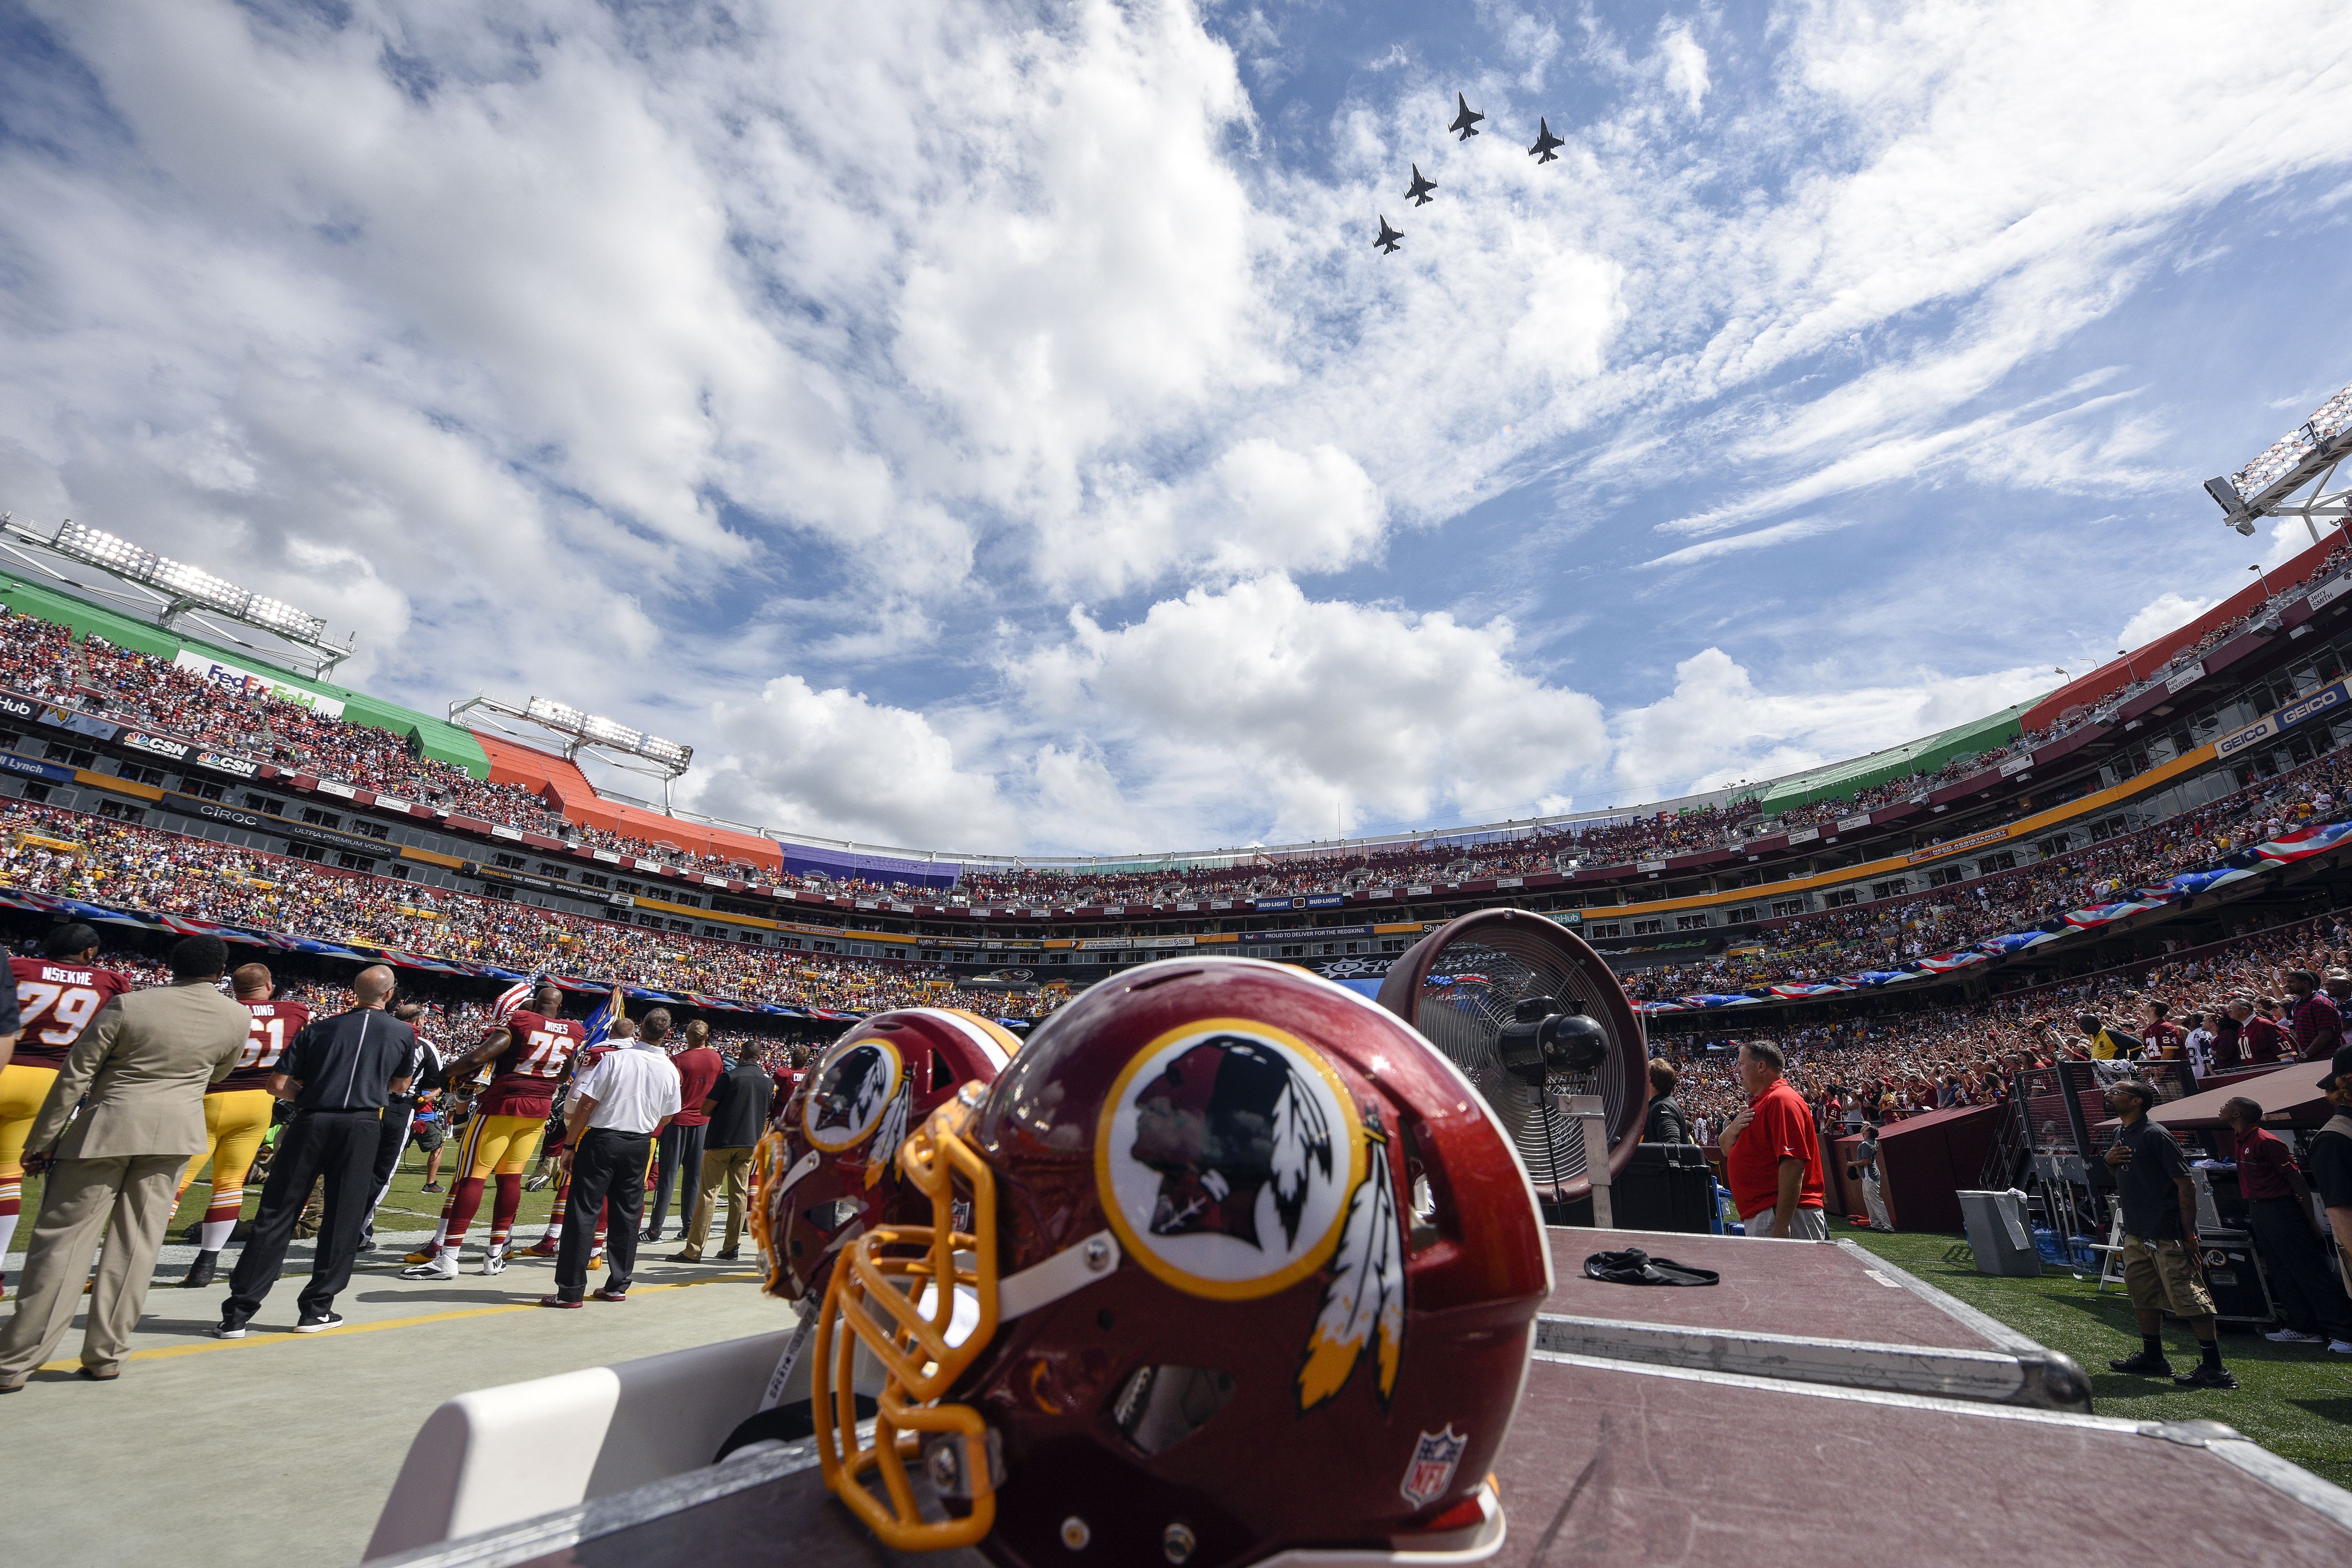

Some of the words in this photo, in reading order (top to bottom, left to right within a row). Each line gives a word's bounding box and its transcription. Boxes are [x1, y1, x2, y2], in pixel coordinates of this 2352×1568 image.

[2310, 590, 2326, 602] Jerry
[2313, 593, 2333, 608] SMITH
[2167, 678, 2177, 687] Ken
[2169, 675, 2194, 692] HOUSTON
[2282, 690, 2337, 724] GEICO
[149, 737, 189, 756] CSN
[2221, 724, 2268, 753] GEICO
[124, 742, 183, 760] CSNMIDATLANTIC.COM
[8, 758, 43, 774] Lynch
[220, 757, 257, 774] CSN
[2002, 766, 2017, 776] HAUSS
[377, 801, 405, 810] THEISMANN
[201, 805, 257, 826] CÎROC
[294, 827, 321, 838] ULTRA
[323, 833, 362, 847] PREMIUM
[364, 843, 391, 854] VODKA
[1954, 830, 2005, 847] ASSISTANCE?
[480, 868, 512, 879] DOWNLOAD
[524, 878, 551, 886] REDSKINS
[557, 884, 579, 893] OFFICIAL
[1424, 924, 1444, 932] Stub
[42, 966, 93, 986] NSEKHE
[16, 981, 101, 1045] 79
[544, 1020, 568, 1035] MOSES
[2146, 1036, 2162, 1057] 24
[2162, 1036, 2178, 1044] 24
[2238, 1036, 2252, 1059] 10
[2278, 1041, 2291, 1051] 10
[513, 1030, 575, 1078] 76
[1409, 1461, 1448, 1497] NFL
